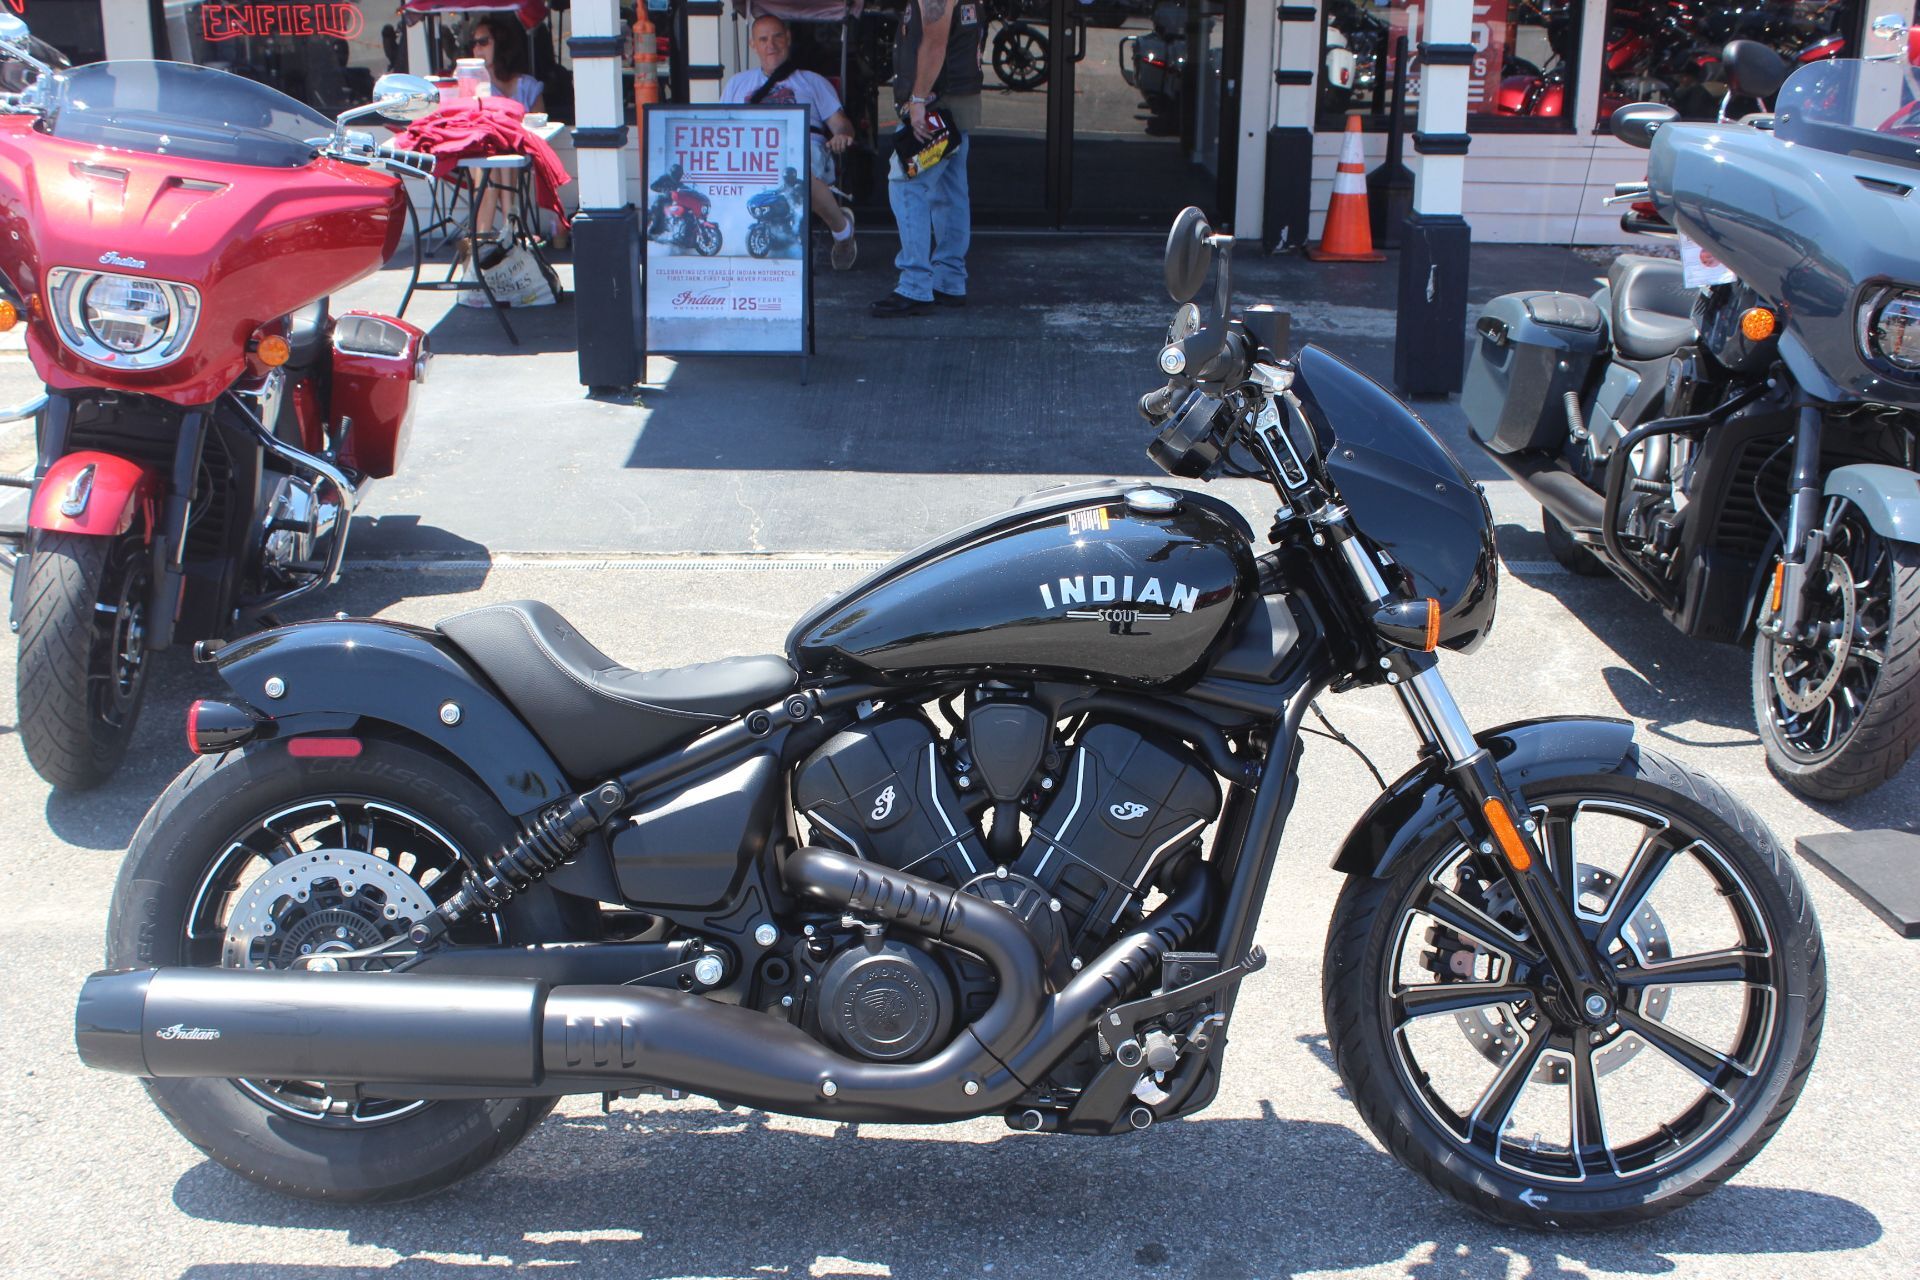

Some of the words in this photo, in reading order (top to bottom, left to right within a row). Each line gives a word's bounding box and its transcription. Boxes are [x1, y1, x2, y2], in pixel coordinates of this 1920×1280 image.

[202, 4, 363, 41] ENFIELD
[751, 128, 779, 149] TO
[675, 151, 719, 171] THE
[728, 152, 779, 172] LINE
[709, 185, 744, 196] EVENT
[99, 251, 146, 269] Indian
[671, 290, 726, 306] Indian
[732, 297, 757, 310] 125
[1039, 575, 1200, 614] INDIAN
[1098, 608, 1140, 622] SCOUT
[160, 1023, 216, 1041] Indian
